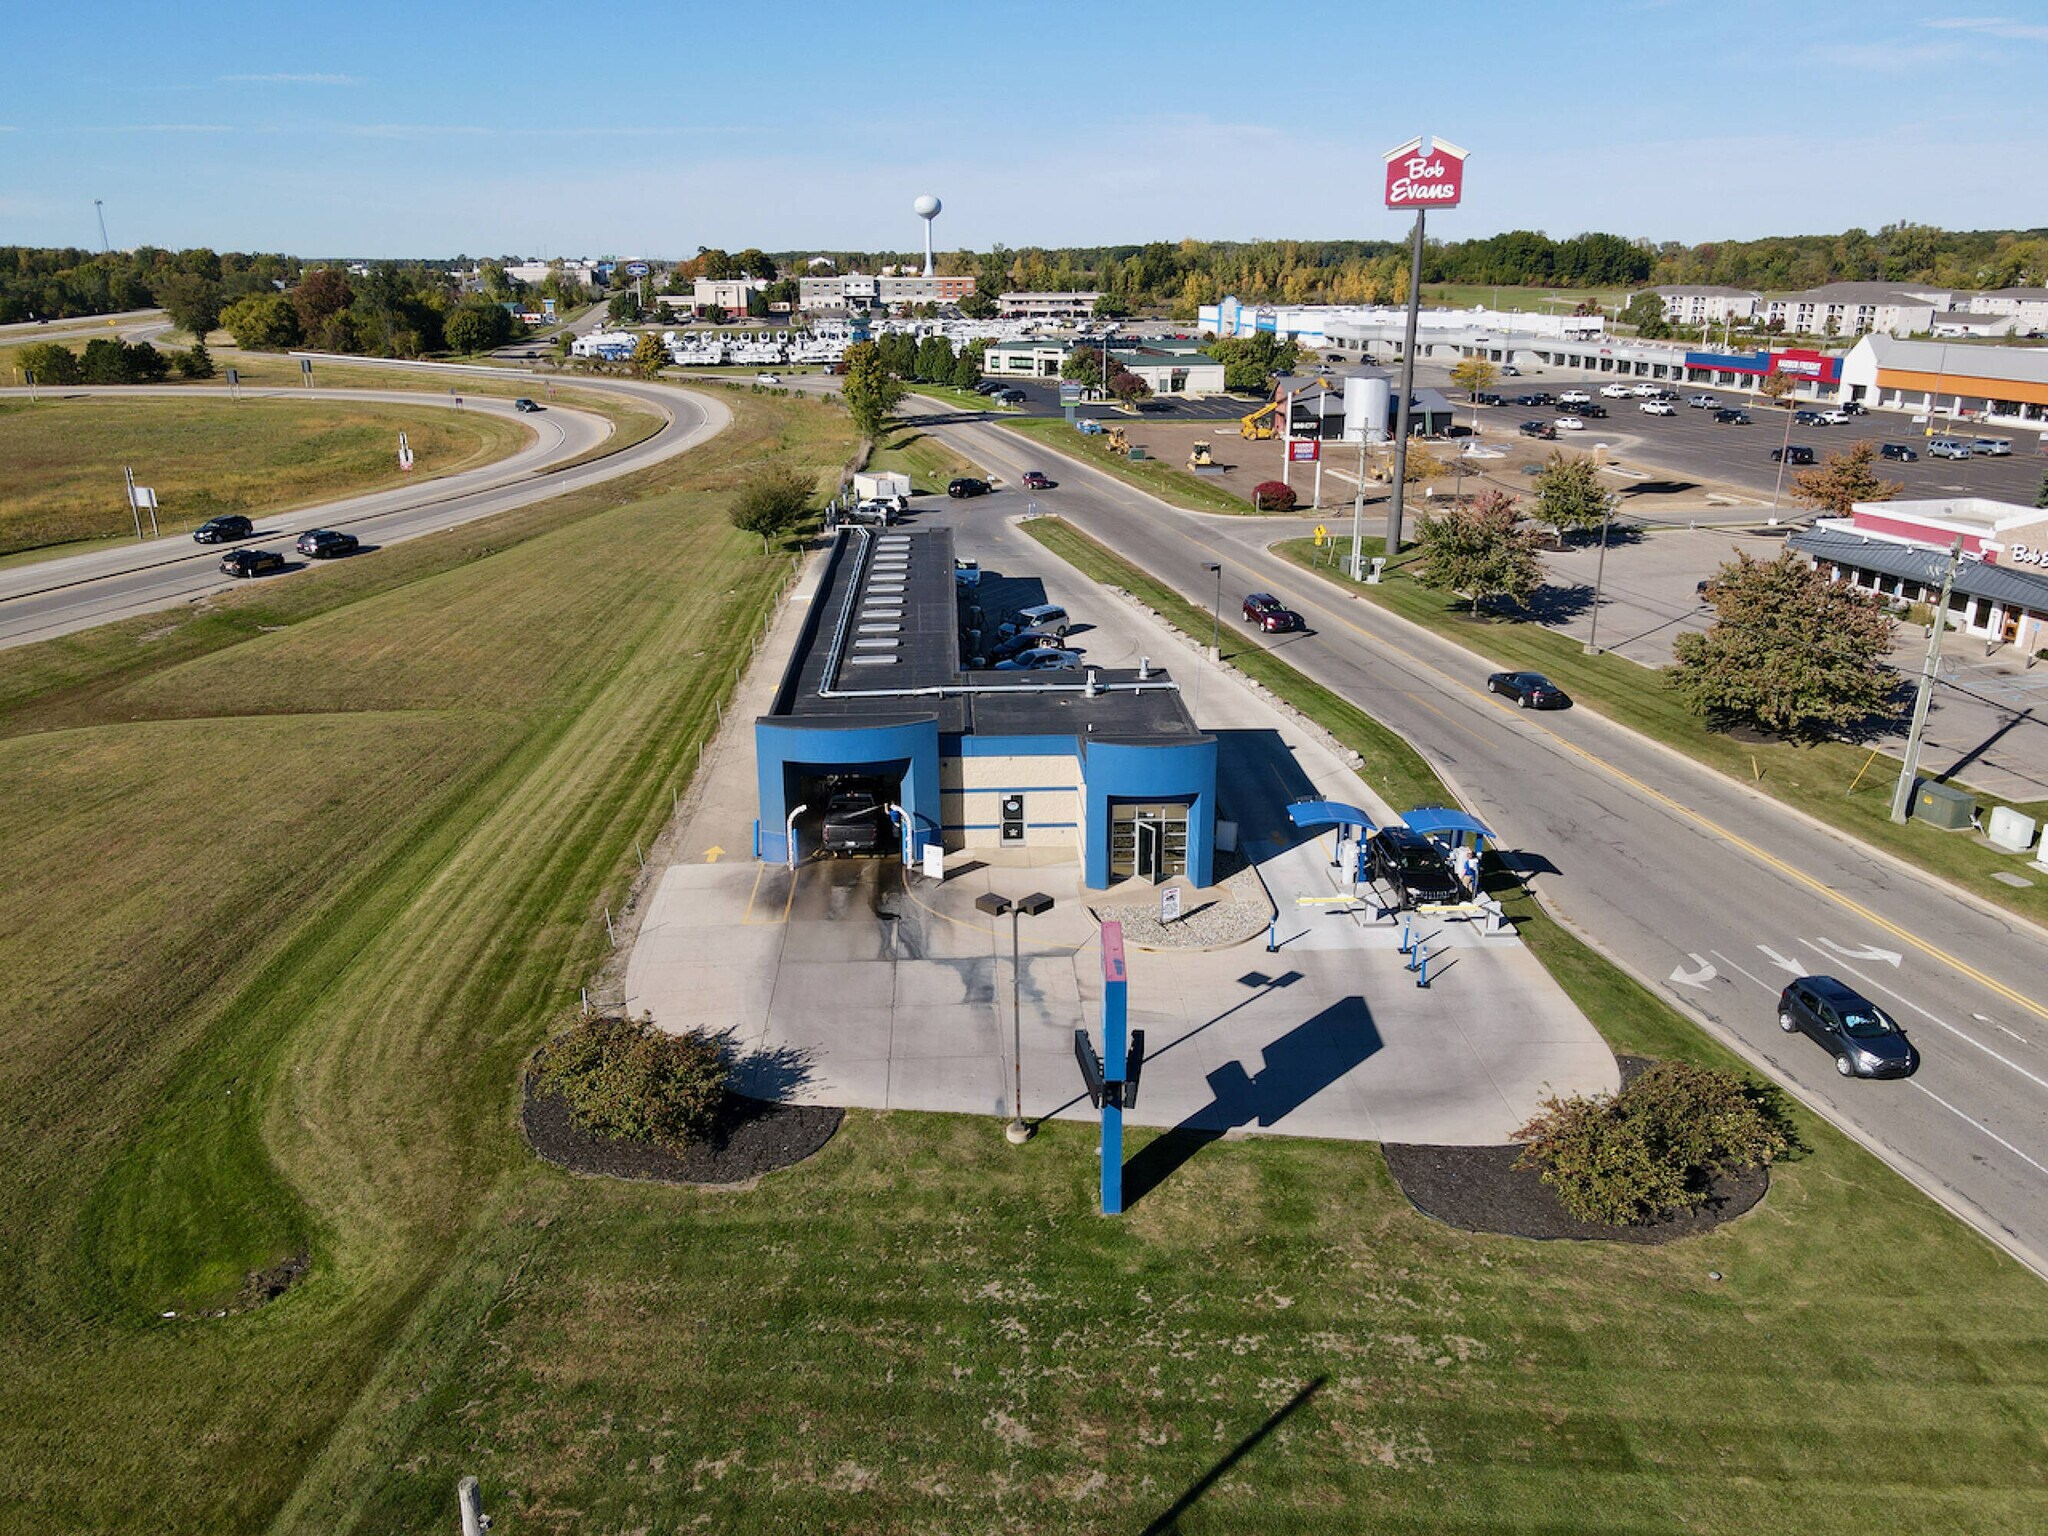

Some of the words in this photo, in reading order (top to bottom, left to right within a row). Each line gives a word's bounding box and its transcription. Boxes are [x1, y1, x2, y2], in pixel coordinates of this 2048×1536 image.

[1404, 158, 1445, 180] Bob
[1390, 177, 1455, 202] Evans
[2010, 543, 2041, 564] Bob
